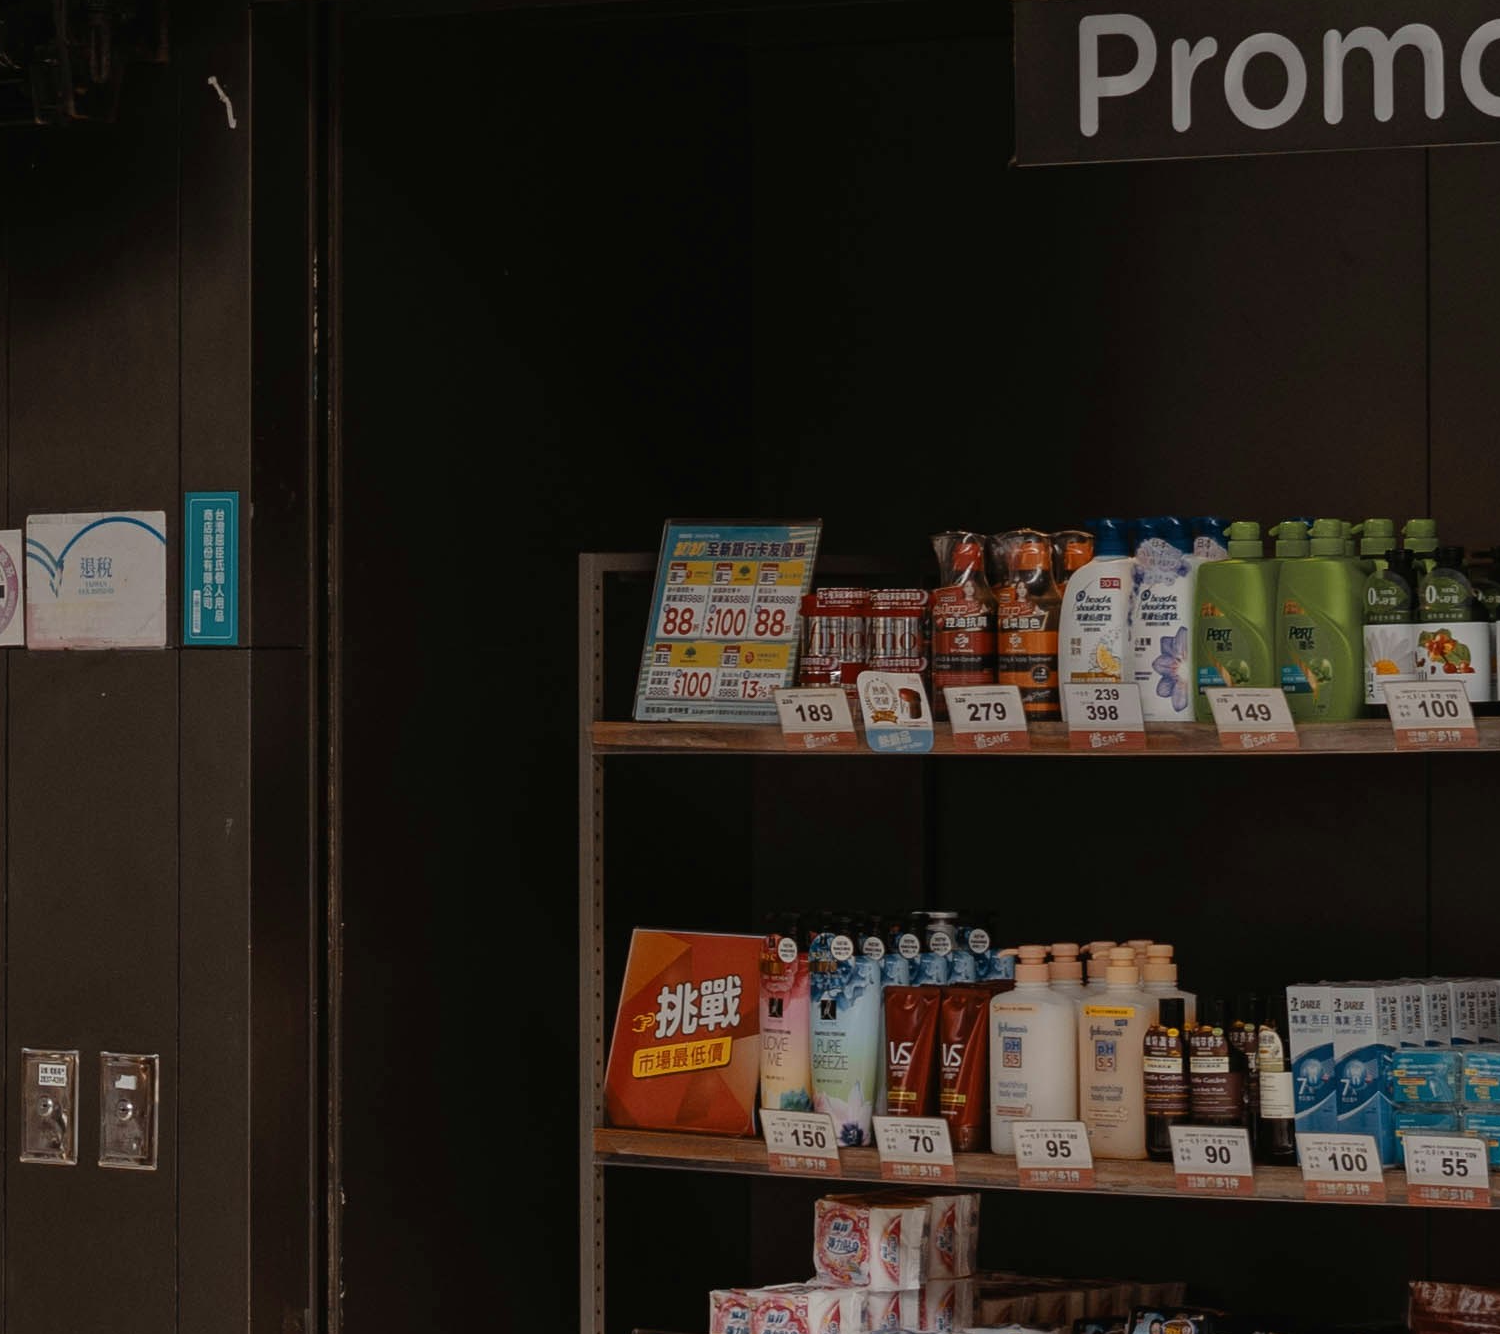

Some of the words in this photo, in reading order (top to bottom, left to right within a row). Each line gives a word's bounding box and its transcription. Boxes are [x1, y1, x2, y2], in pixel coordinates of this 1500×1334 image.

[706, 541, 806, 558] 全新銀行卡友優惠
[80, 556, 113, 580] 退稅
[663, 607, 694, 635] 88
[705, 608, 746, 636] $100
[755, 608, 785, 637] 88
[673, 671, 711, 698] $100
[1095, 688, 1119, 701] 239
[795, 703, 833, 723] 189
[967, 702, 1006, 722] 279
[1086, 705, 1119, 721] 398
[1231, 703, 1272, 722] 149
[1417, 699, 1458, 719] 100
[655, 975, 742, 1039] 挑戰
[763, 1039, 789, 1052] LOVE
[816, 1039, 843, 1053] PURE
[889, 1041, 913, 1066] VS
[940, 1042, 962, 1067] VS
[1005, 1038, 1020, 1051] pH
[638, 1040, 726, 1074] 市場最低價
[767, 1053, 783, 1067] ME
[813, 1054, 848, 1069] BREEZE
[791, 1129, 826, 1149] 150
[910, 1134, 935, 1154] 70
[1046, 1140, 1072, 1158] 95
[1204, 1145, 1231, 1165] 90
[1328, 1153, 1368, 1173] 100
[1441, 1158, 1469, 1178] 55
